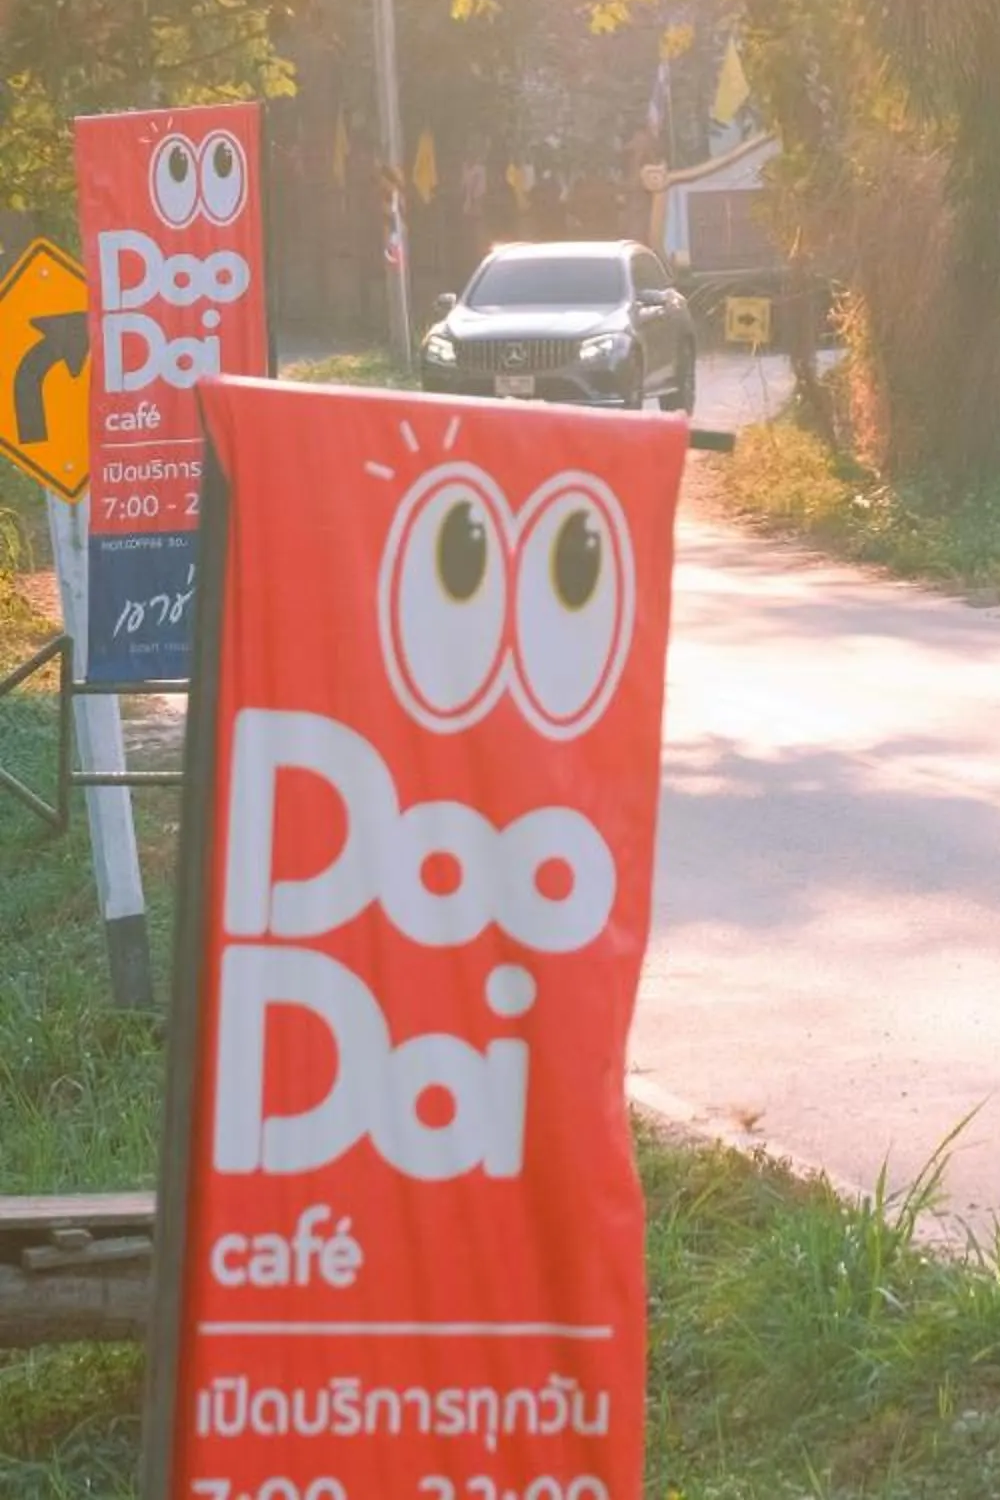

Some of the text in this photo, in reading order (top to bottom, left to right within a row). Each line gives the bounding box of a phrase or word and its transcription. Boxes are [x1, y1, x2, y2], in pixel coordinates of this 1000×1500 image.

[98, 230, 250, 311] Doo
[103, 308, 221, 393] Dai
[105, 400, 161, 432] café
[103, 459, 203, 484] เปิดบริการ
[103, 494, 159, 521] 7:00
[223, 708, 617, 954] Doo
[212, 944, 537, 1183] Dai
[210, 1204, 363, 1288] café
[195, 1372, 610, 1454] เปิดบริการทุกวัน
